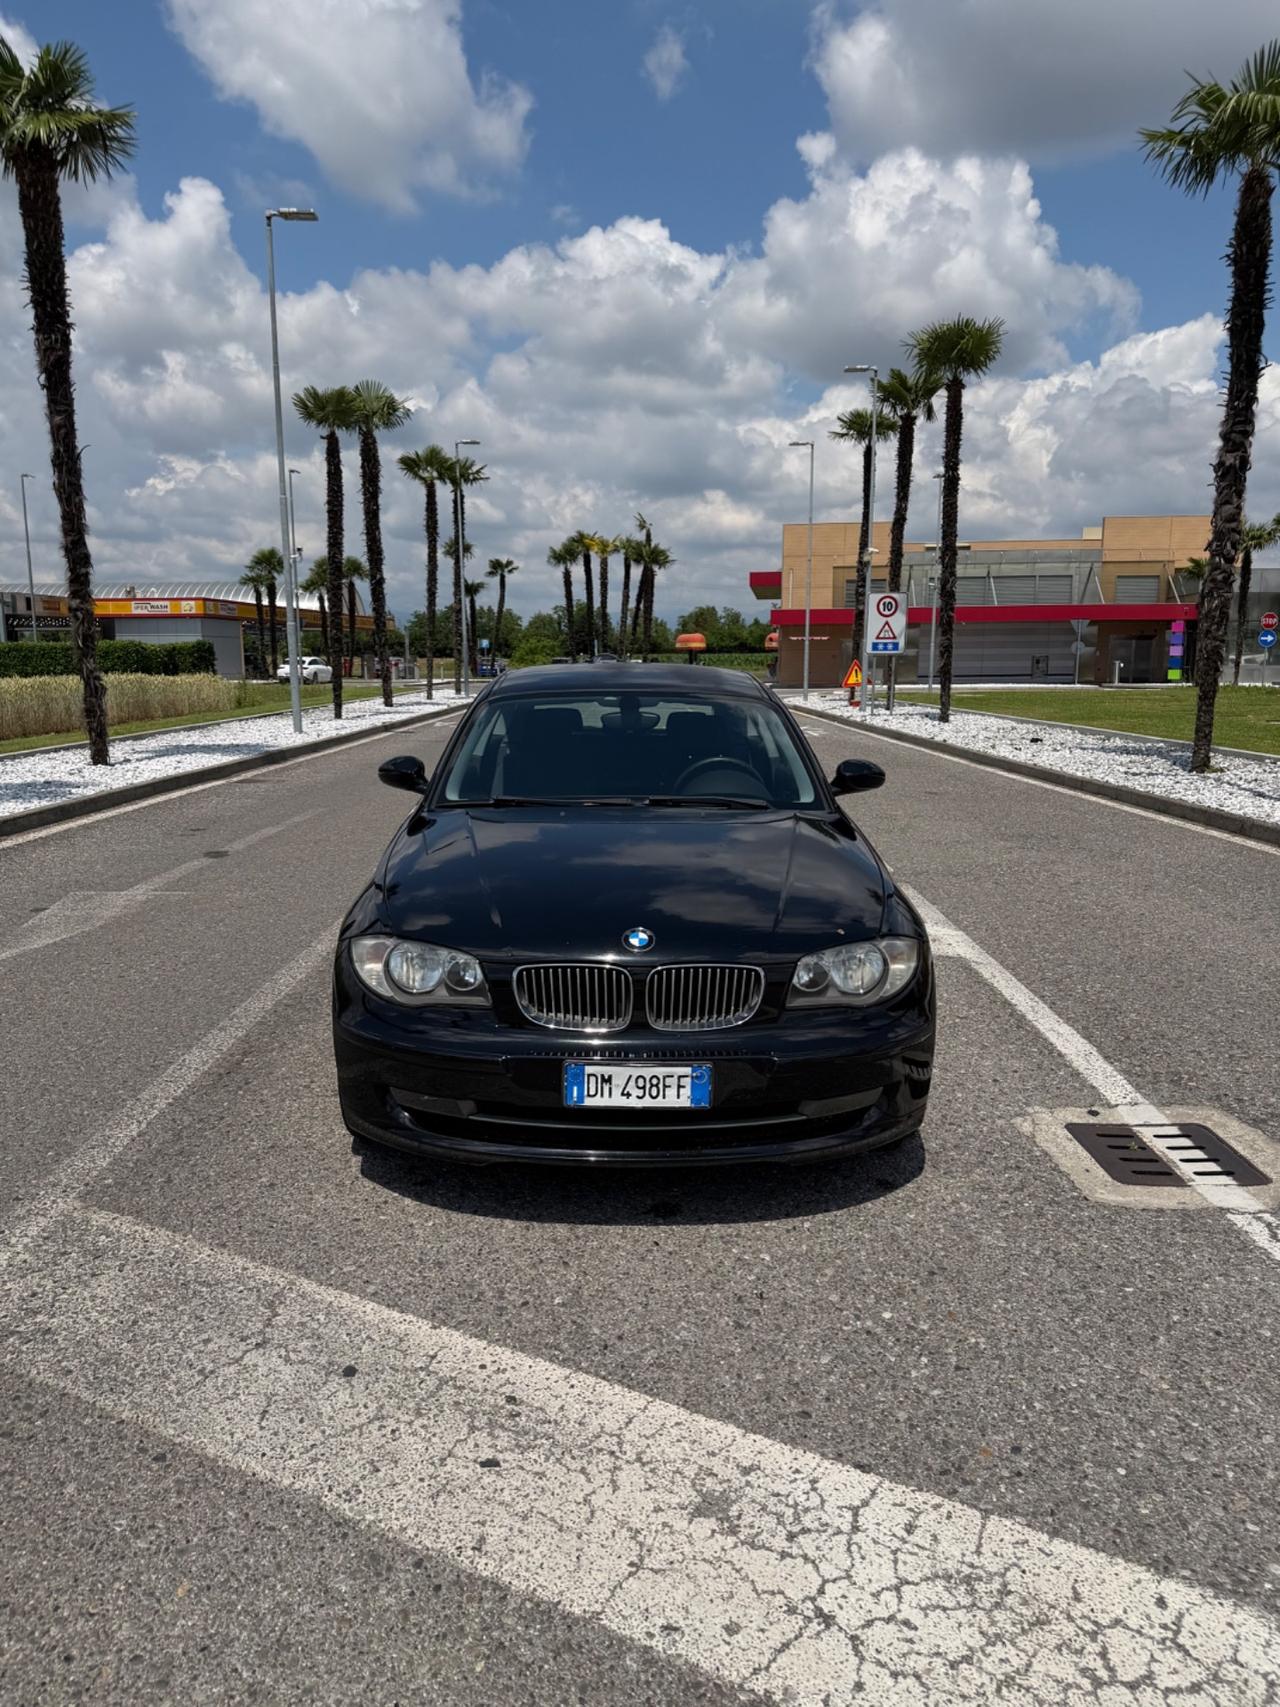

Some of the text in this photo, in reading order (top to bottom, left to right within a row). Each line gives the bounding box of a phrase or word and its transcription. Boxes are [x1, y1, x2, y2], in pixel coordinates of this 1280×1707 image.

[882, 601, 893, 612] 10
[1262, 617, 1277, 625] STOP
[587, 1073, 612, 1098] DM
[620, 1074, 690, 1100] 498FF
